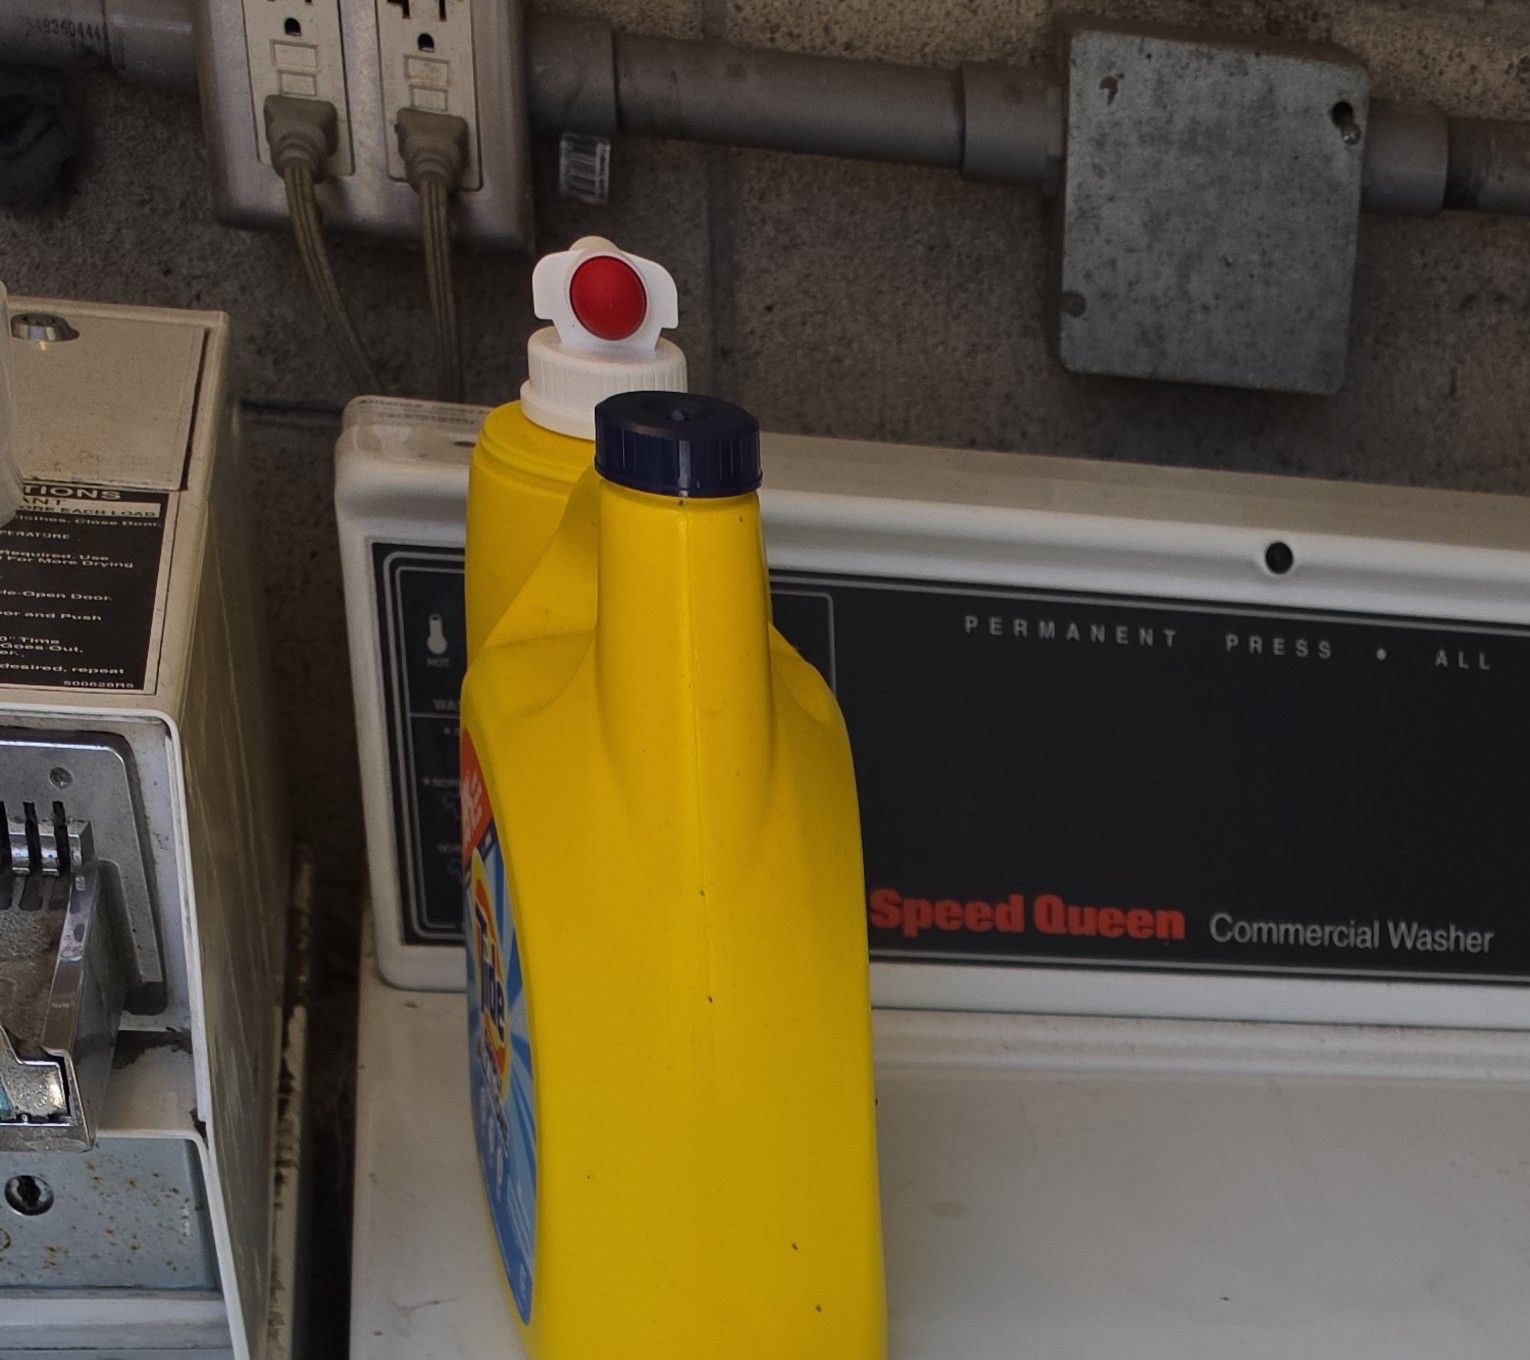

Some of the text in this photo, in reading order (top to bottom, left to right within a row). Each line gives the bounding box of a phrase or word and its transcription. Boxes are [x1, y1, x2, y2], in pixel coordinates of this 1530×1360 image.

[24, 484, 121, 500] TIONS
[60, 507, 106, 515] EACH
[0, 530, 70, 539] PERATURE
[38, 557, 78, 566] More
[82, 560, 134, 569] Drying
[25, 611, 56, 619] and
[61, 613, 102, 621] Push
[20, 636, 60, 645] Time
[964, 614, 1178, 648] PERMANENT
[1226, 633, 1332, 659] PRESS
[1435, 649, 1491, 671] ALL
[72, 666, 125, 675] repeat
[870, 888, 1495, 953] Speed Queen Commercial Washer
